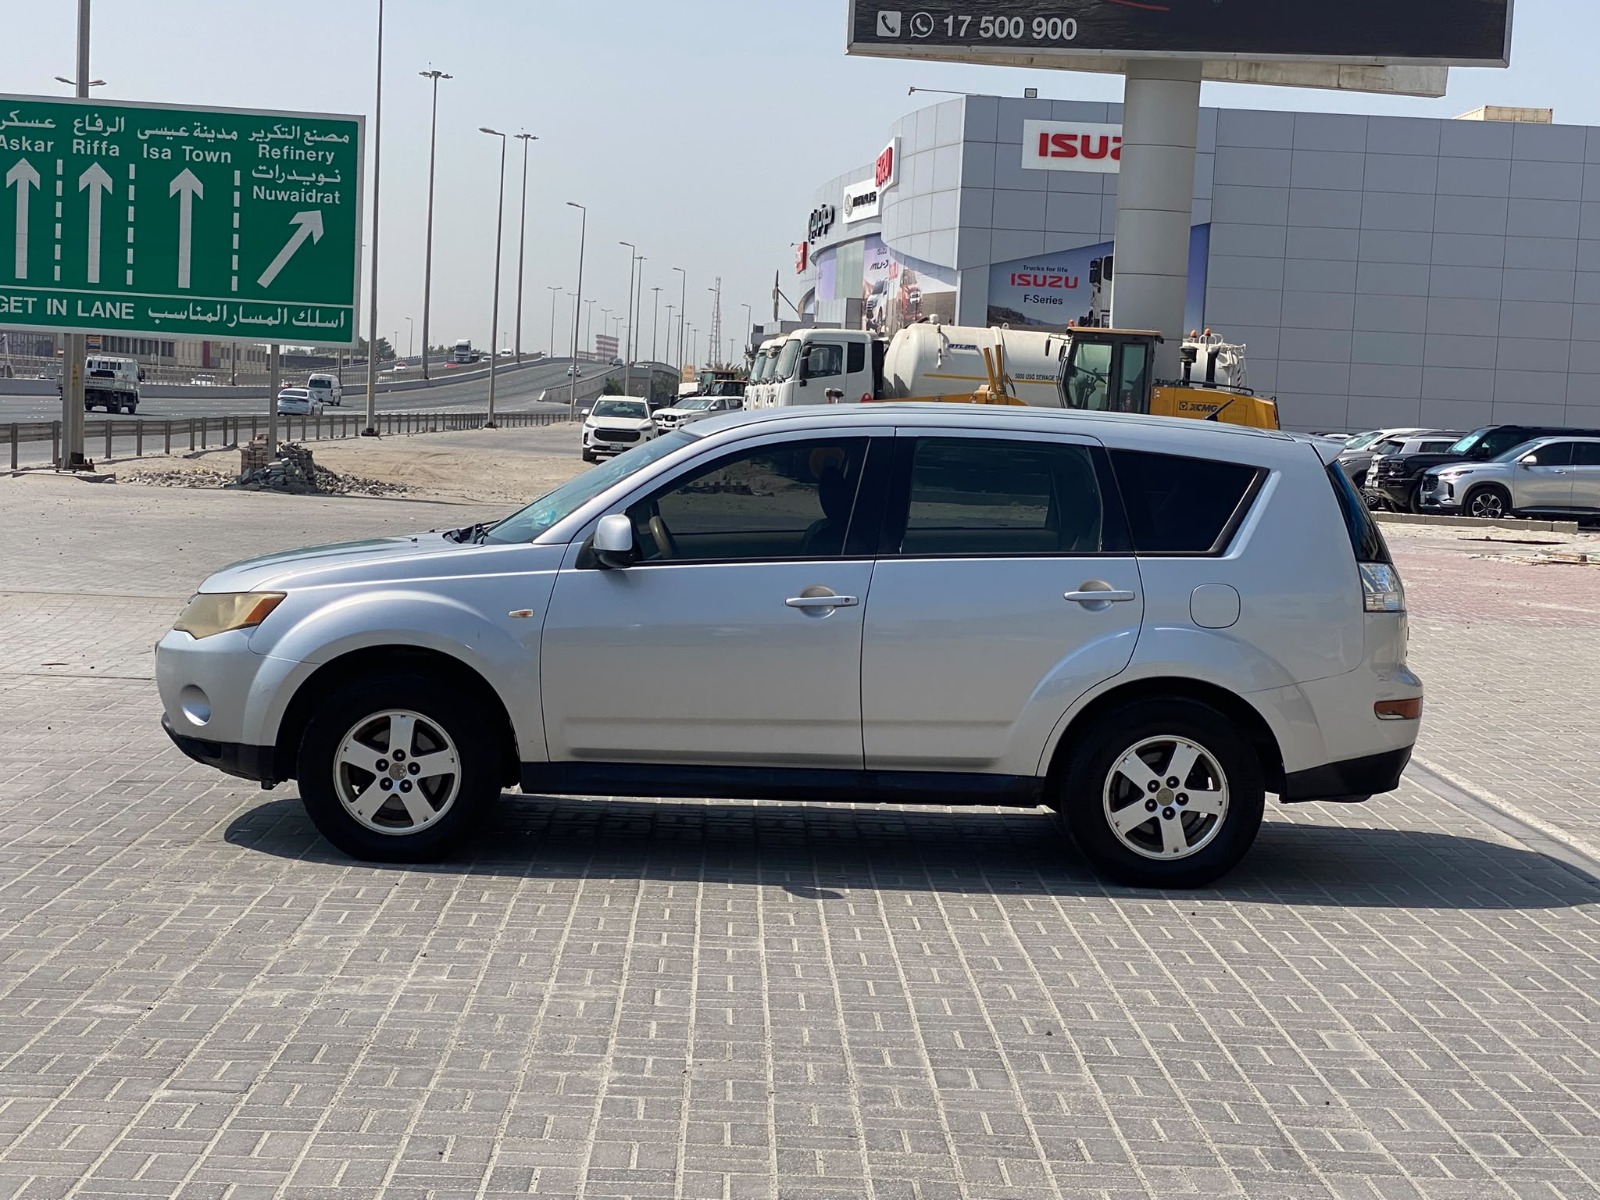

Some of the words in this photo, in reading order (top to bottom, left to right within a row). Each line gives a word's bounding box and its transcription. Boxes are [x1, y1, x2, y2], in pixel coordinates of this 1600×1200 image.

[943, 15, 972, 37] 17
[979, 16, 1024, 38] 500
[1032, 17, 1077, 40] 900
[0, 110, 57, 130] عسكر
[73, 113, 125, 136] الرفاع
[137, 126, 189, 140] عيسى
[193, 121, 239, 143] مدينة
[248, 124, 300, 142] التكرير
[303, 129, 350, 146] مصنع
[0, 134, 54, 152] Askar
[72, 138, 120, 157] Riffa
[1039, 132, 1121, 161] ISU
[143, 143, 172, 160] Isa
[182, 145, 231, 164] Town
[258, 144, 335, 165] Refinery
[252, 163, 341, 186] نويدرات
[252, 185, 340, 205] Nuwaidrat
[1023, 264, 1044, 272] Trucks
[1010, 273, 1079, 289] ISUZU
[0, 295, 37, 314] GET
[46, 298, 67, 316] IN
[77, 300, 135, 319] LANE
[1023, 294, 1063, 305] F-Series
[148, 302, 227, 325] المناسب
[227, 304, 288, 328] المسار
[292, 308, 345, 329] اسلك
[1188, 403, 1218, 412] XCMG
